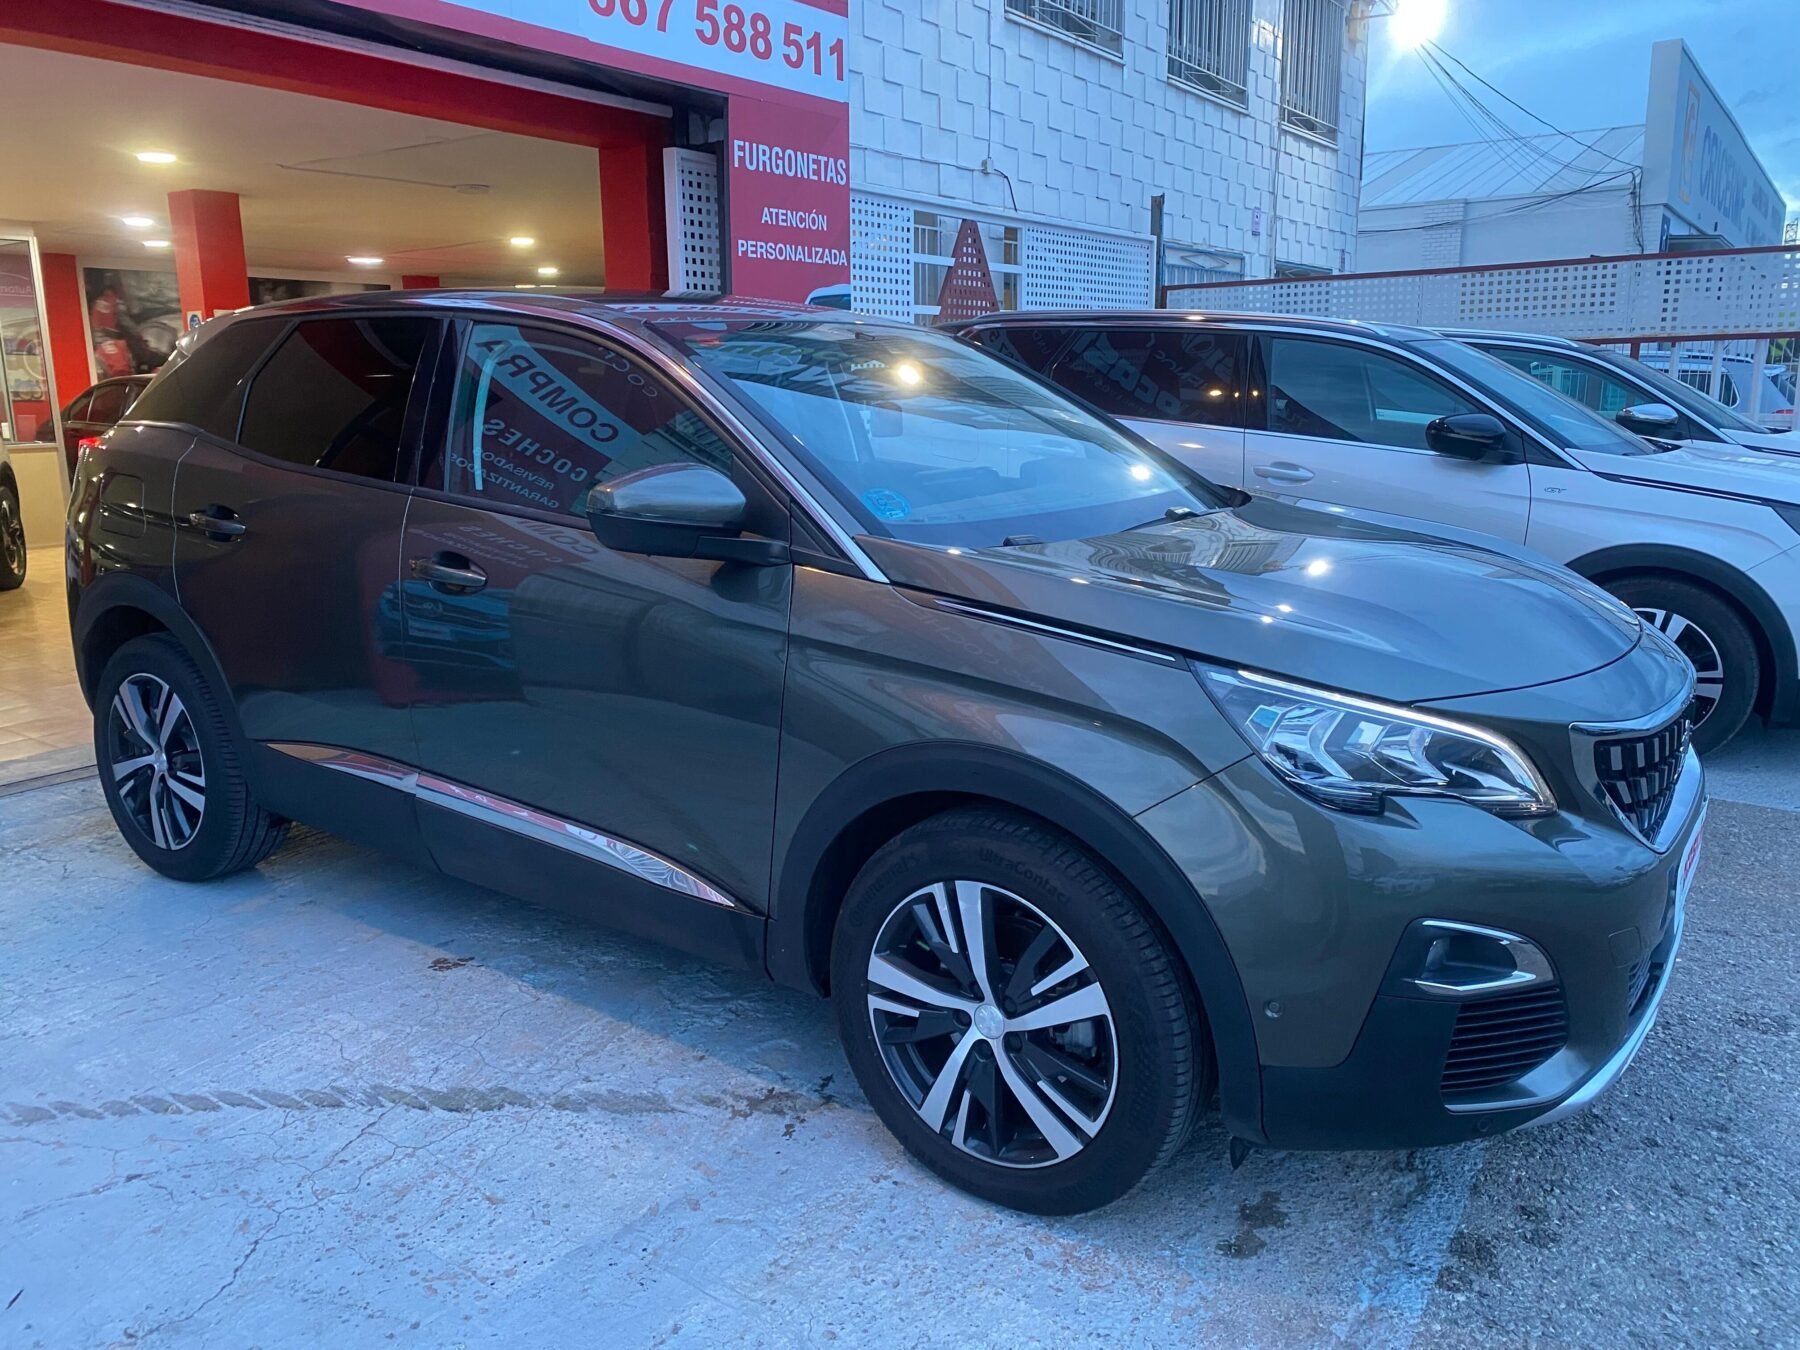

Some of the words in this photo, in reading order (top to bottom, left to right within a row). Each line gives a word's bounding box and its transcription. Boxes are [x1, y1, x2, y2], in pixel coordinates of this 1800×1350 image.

[695, 0, 772, 61] 588
[782, 22, 845, 82] 511
[733, 139, 847, 186] FURGONETAS
[761, 206, 828, 231] ATENCIÓN
[738, 239, 848, 266] PERSONALIZADA
